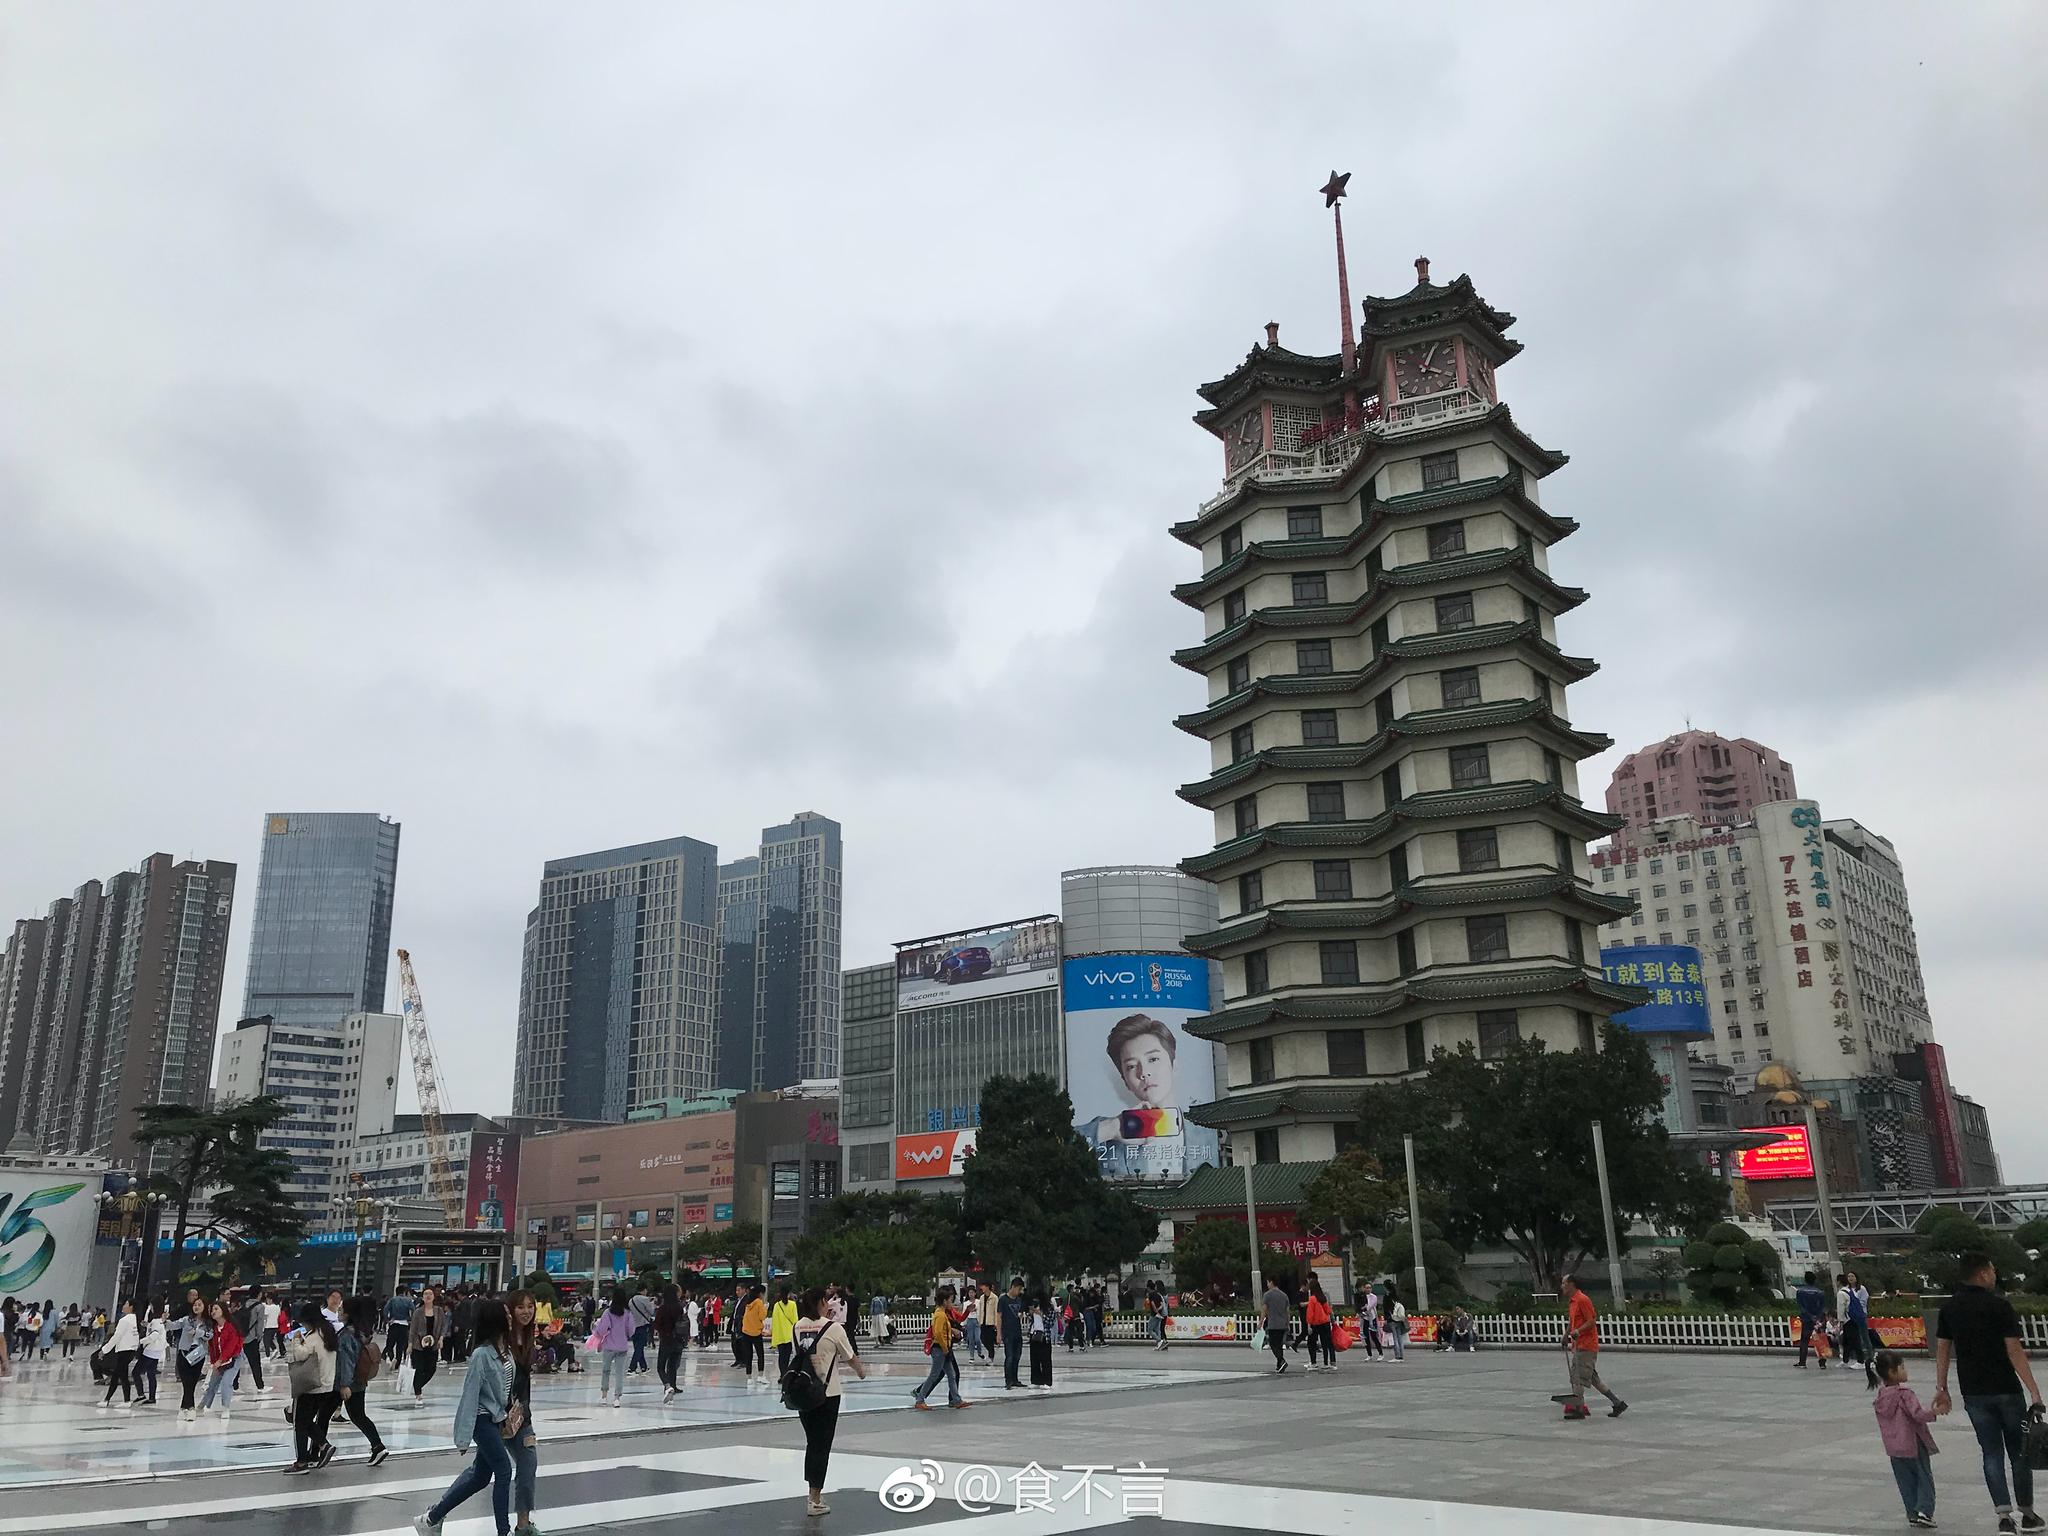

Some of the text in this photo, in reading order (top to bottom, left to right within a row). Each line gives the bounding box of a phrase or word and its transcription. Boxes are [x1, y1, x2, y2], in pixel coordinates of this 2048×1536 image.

[1803, 829, 1831, 909] 大商集团
[1779, 855, 1813, 988] 7天连锁酒店
[1084, 969, 1135, 985] vivo
[1164, 972, 1192, 981] RUSSIA
[1165, 980, 1183, 988] 2018
[1088, 1144, 1213, 1161] 21 屏幕指纹手机
